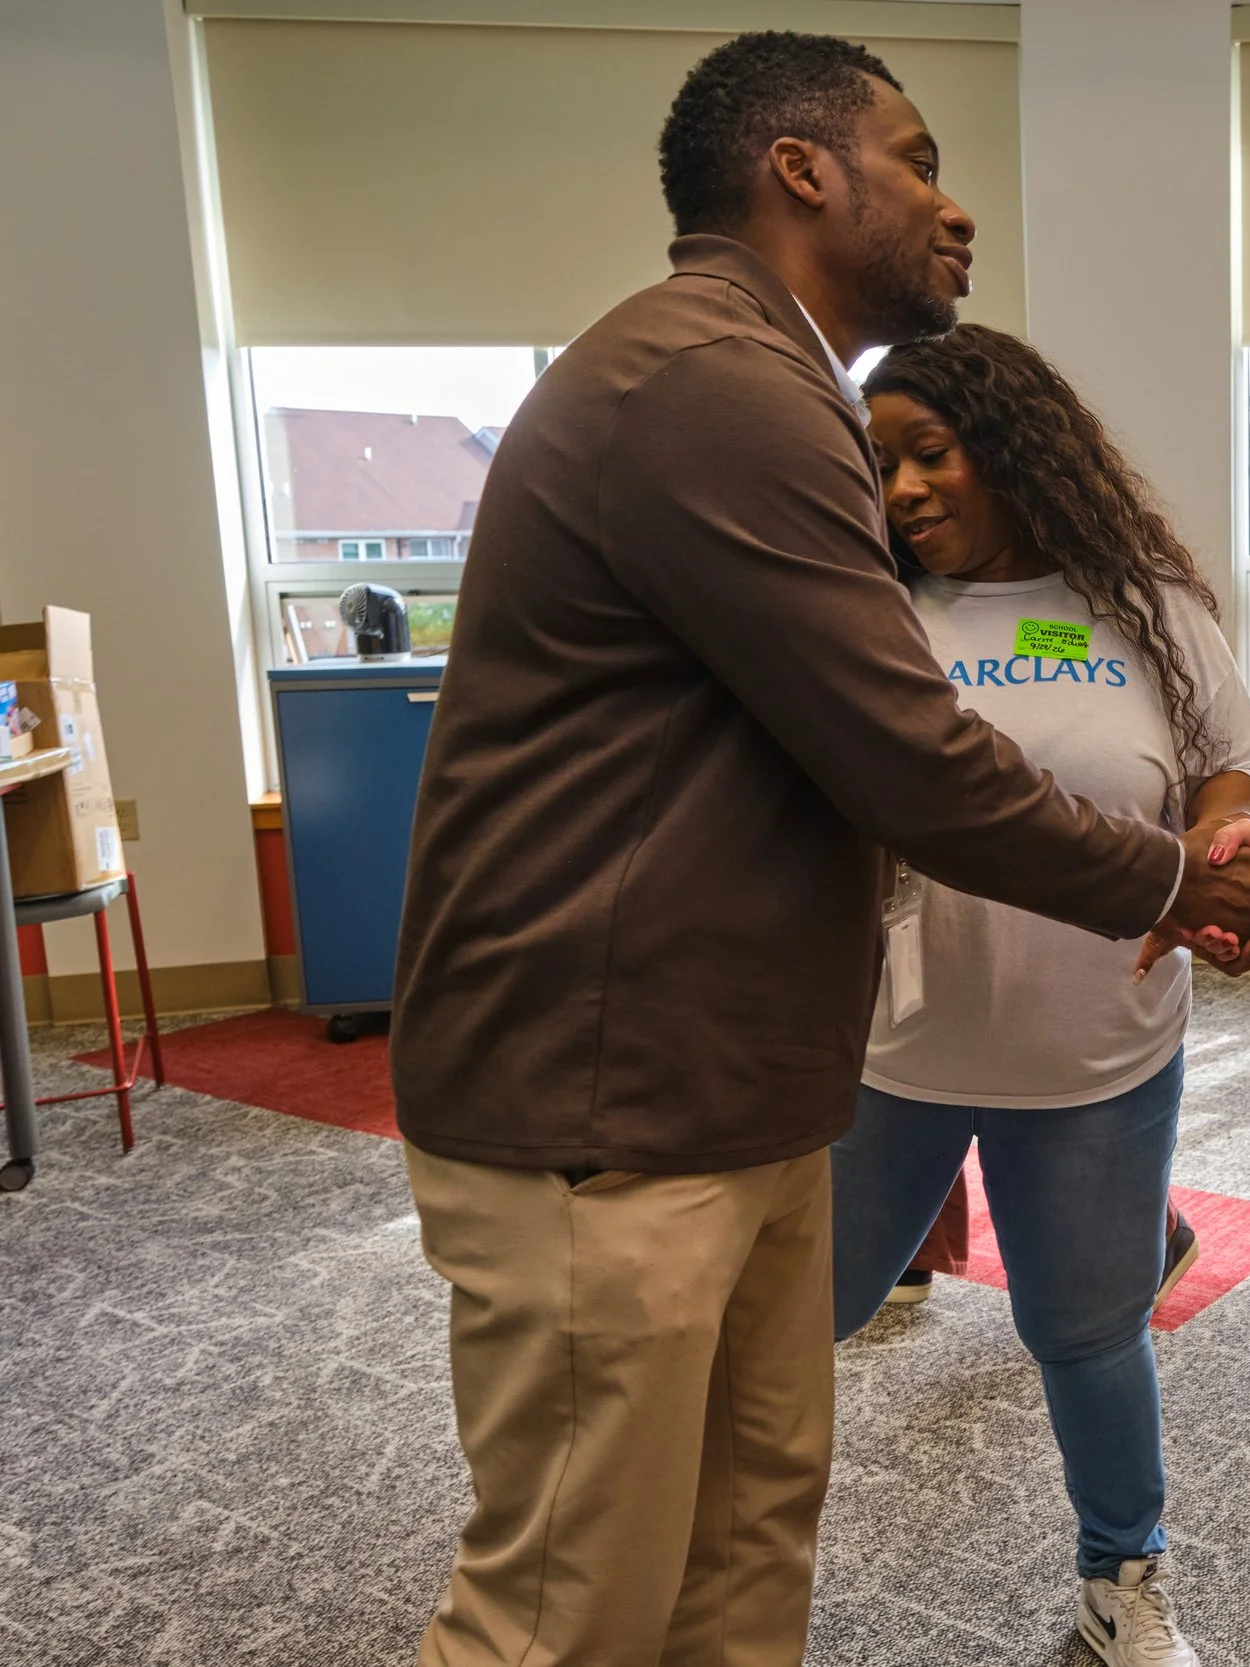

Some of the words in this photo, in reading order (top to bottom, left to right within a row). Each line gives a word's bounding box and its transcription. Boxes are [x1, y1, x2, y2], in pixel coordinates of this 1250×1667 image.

[1049, 624, 1078, 633] SCHOOL
[1040, 629, 1085, 641] VISITOR
[947, 655, 1127, 687] ARCLAYS
